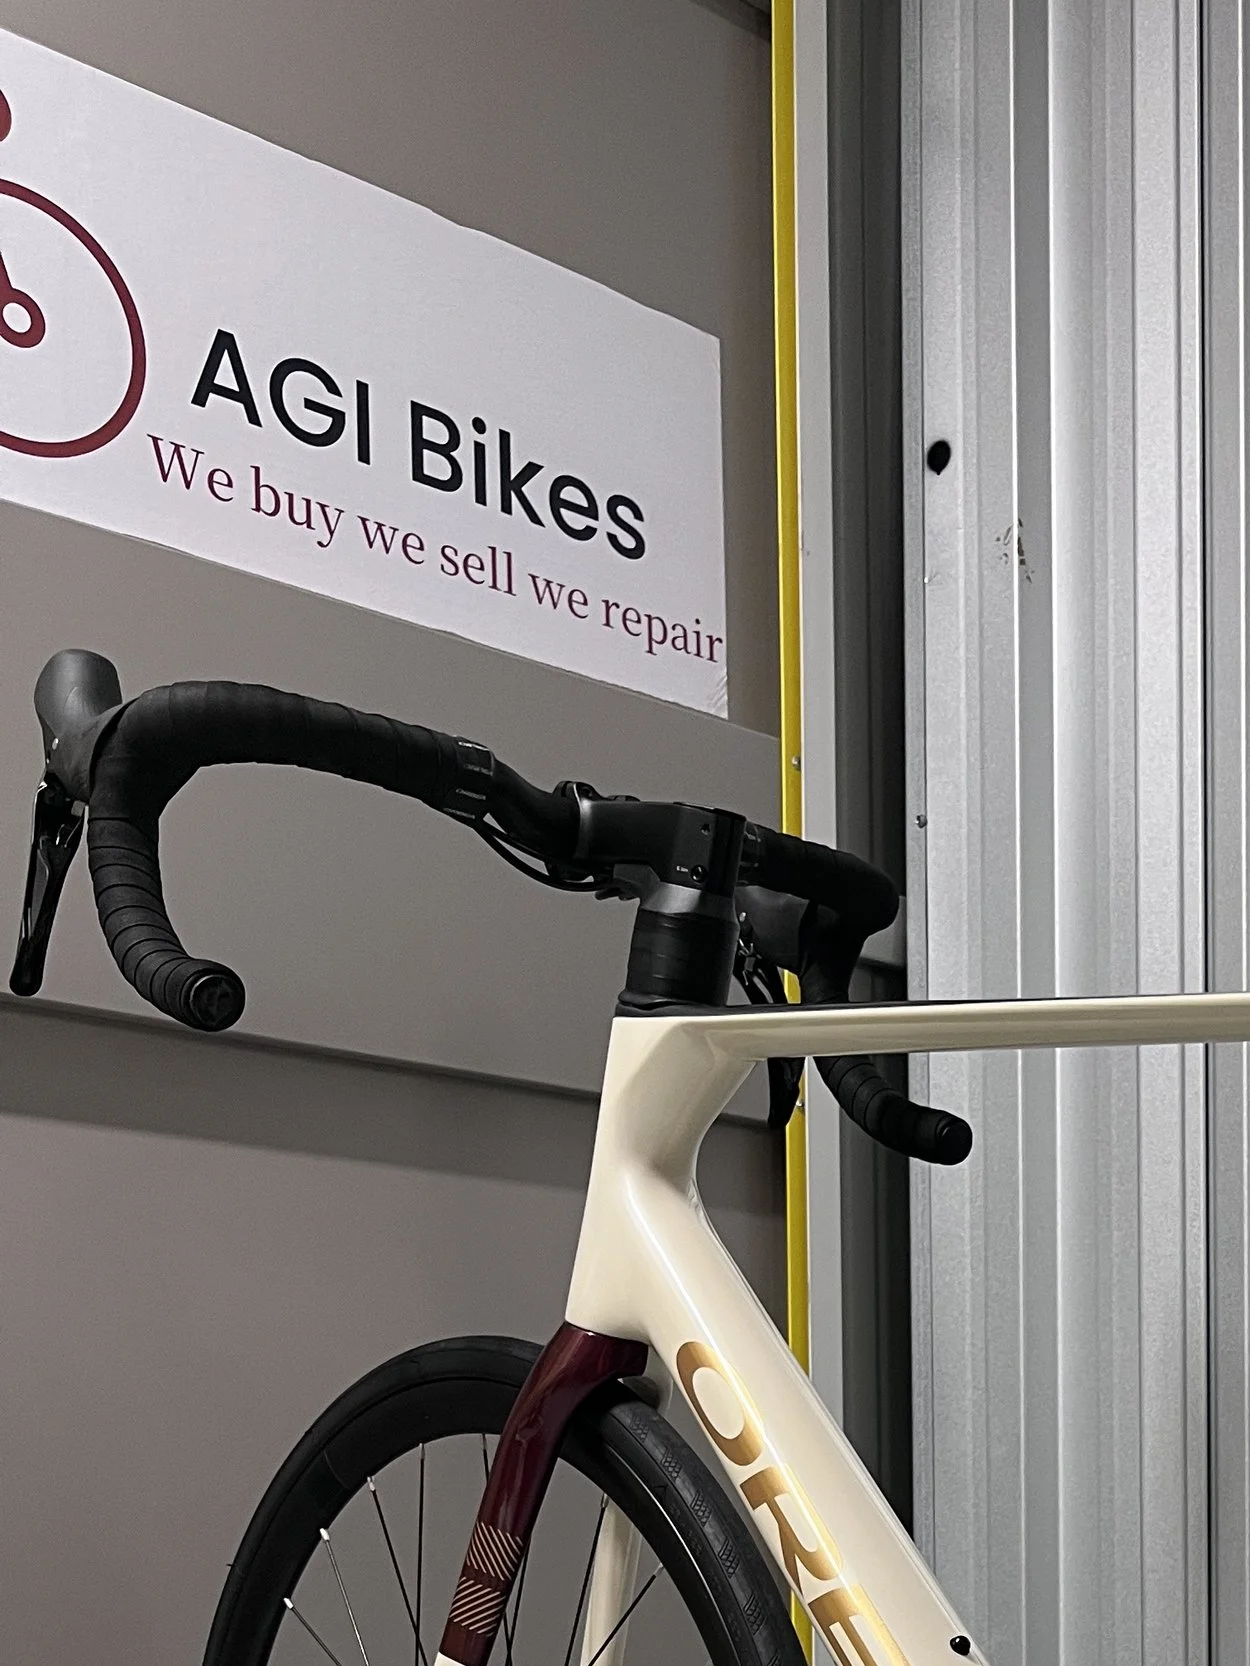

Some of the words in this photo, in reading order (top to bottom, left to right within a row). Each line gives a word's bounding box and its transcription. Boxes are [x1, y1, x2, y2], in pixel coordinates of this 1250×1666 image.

[146, 433, 234, 503] We
[249, 465, 345, 548] buy
[356, 515, 425, 565] we
[440, 545, 517, 597] sell
[527, 573, 589, 620] we
[601, 599, 724, 663] repair
[190, 328, 371, 466] AGI
[410, 399, 646, 560] Bikes
